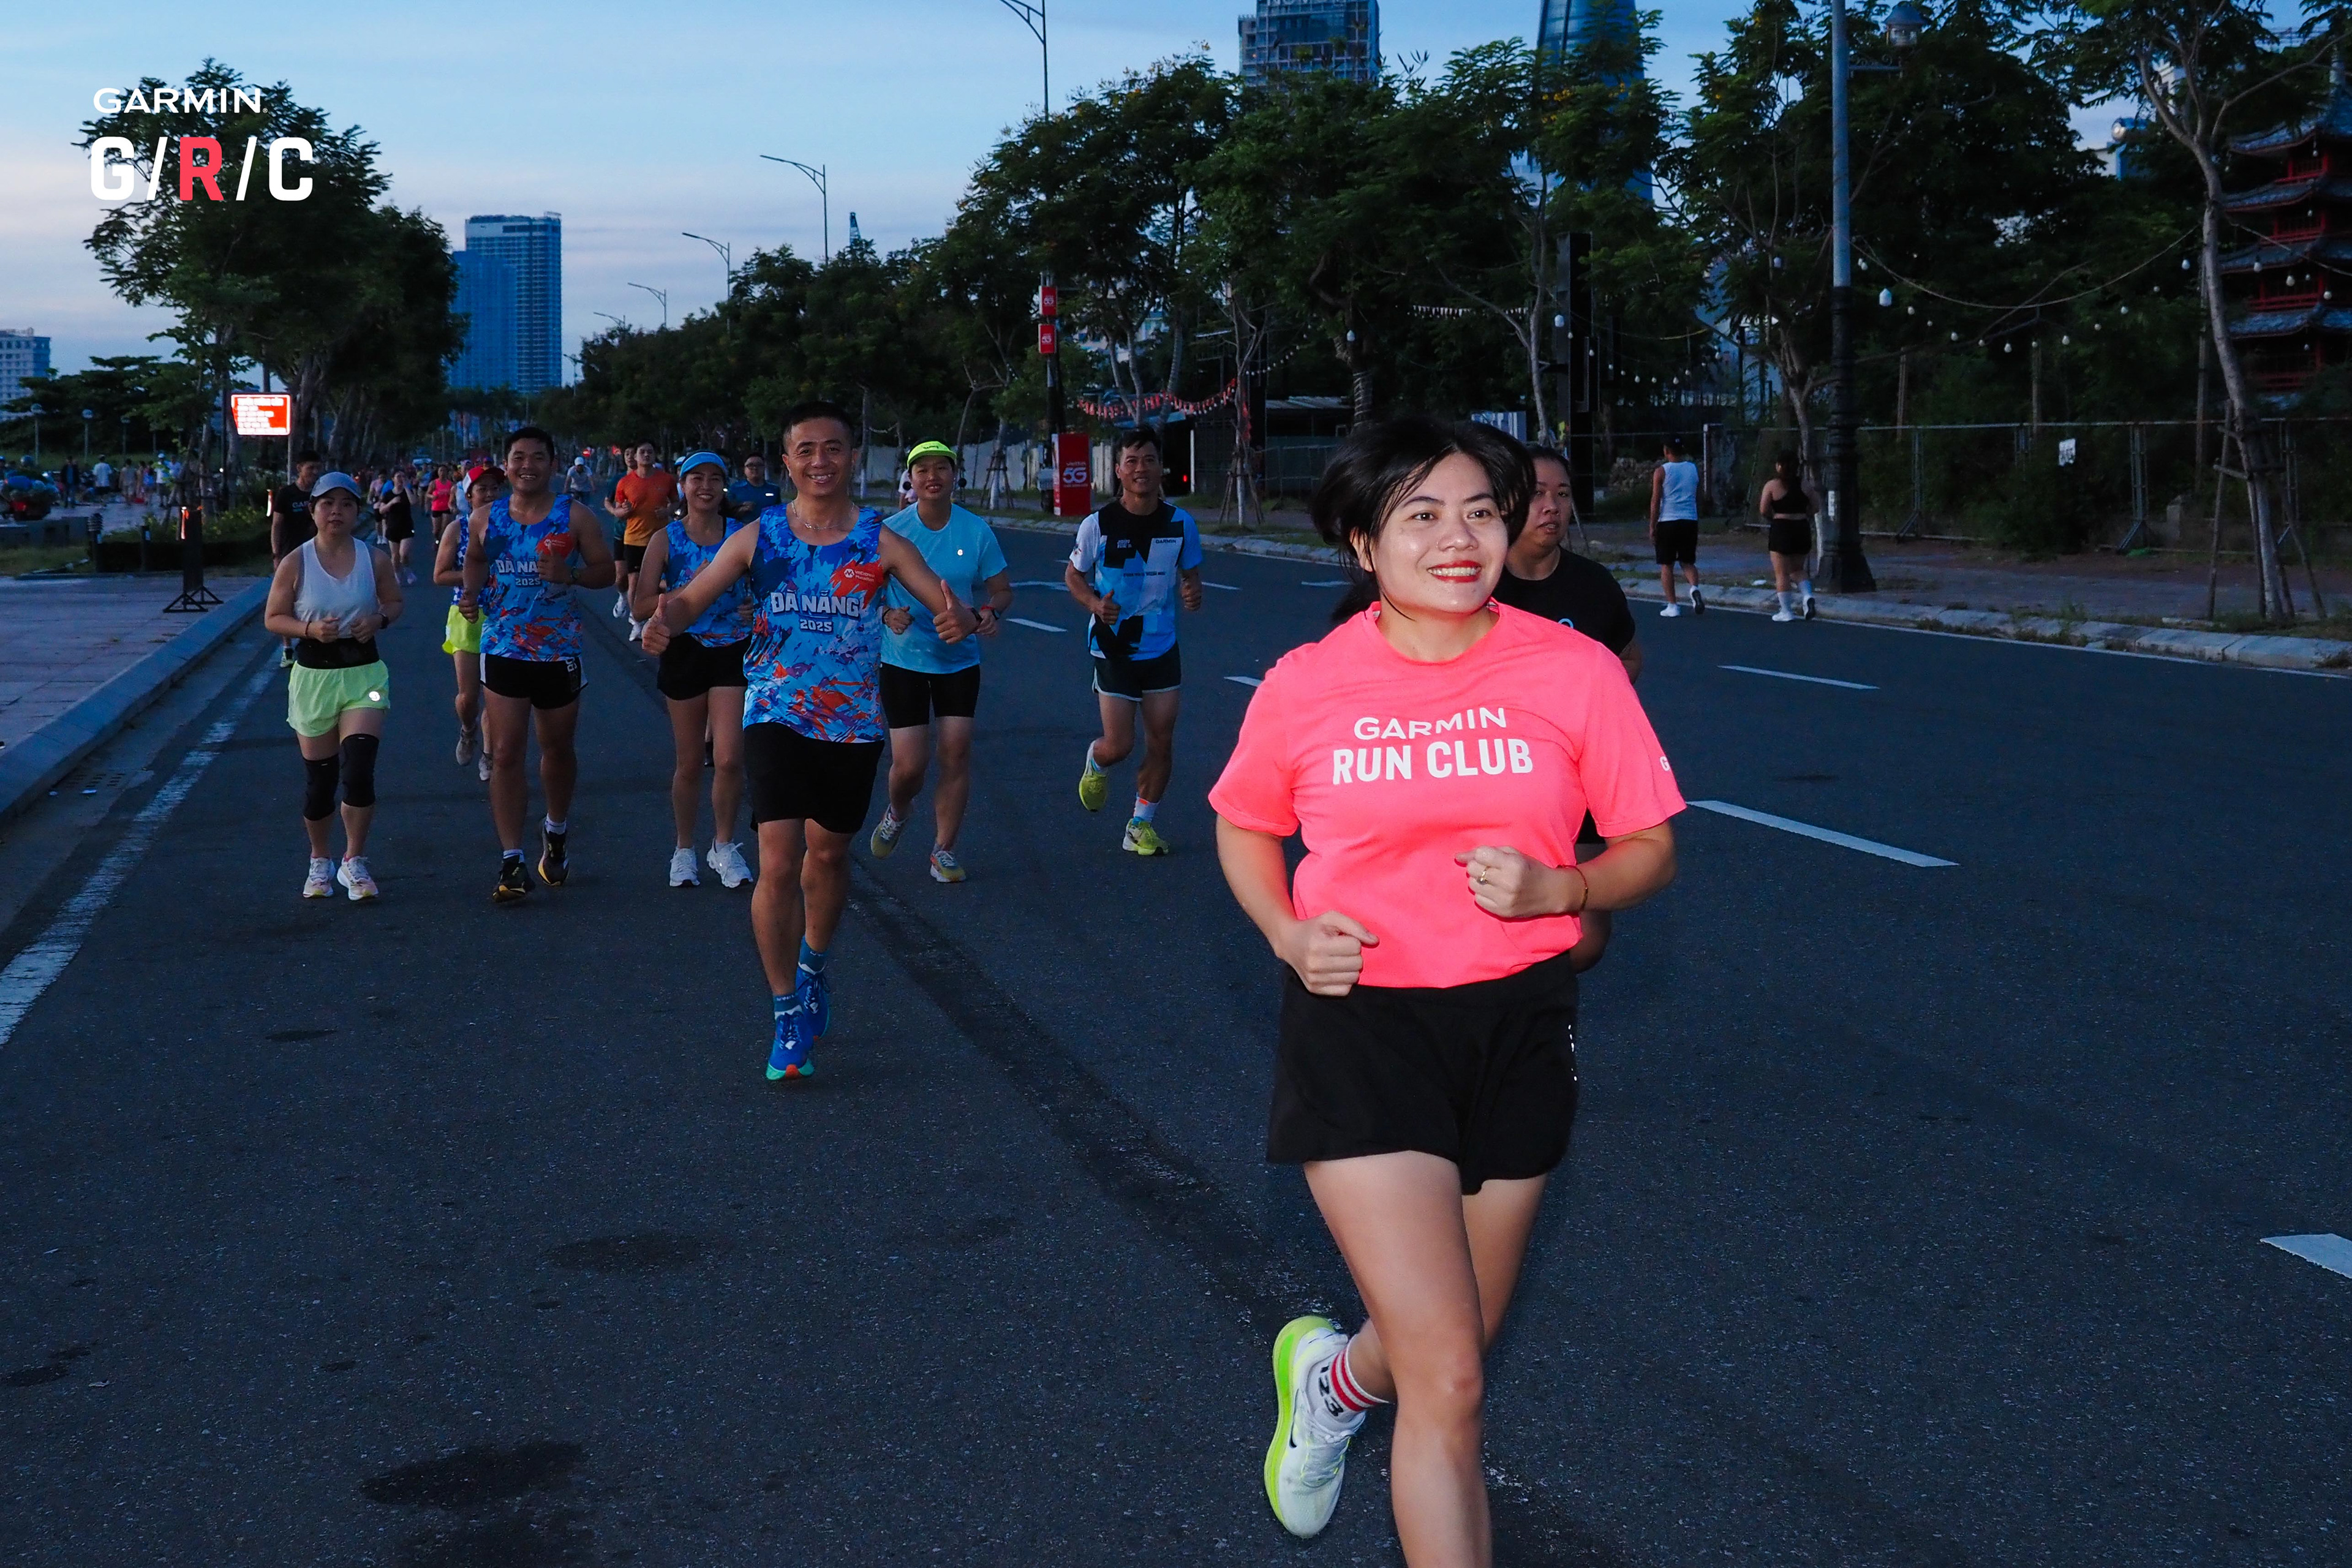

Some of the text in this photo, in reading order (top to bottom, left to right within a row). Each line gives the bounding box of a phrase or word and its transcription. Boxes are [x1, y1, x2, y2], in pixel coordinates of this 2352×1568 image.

[1063, 467, 1087, 483] 5G
[771, 589, 799, 613] ĐÀ
[800, 619, 832, 632] 2025
[1354, 707, 1507, 740] GARMIN
[1333, 738, 1533, 785] RUN CLUB
